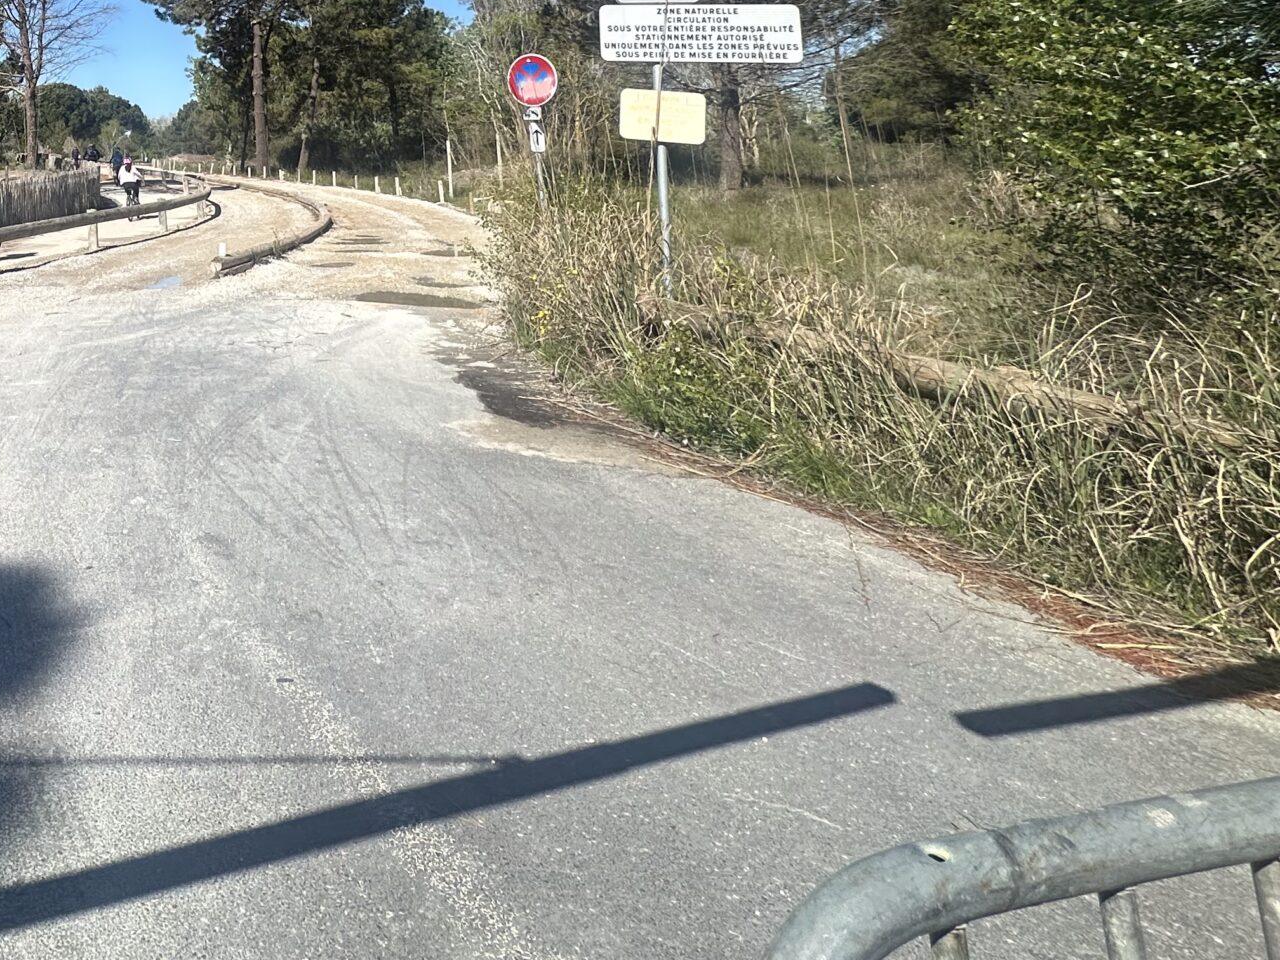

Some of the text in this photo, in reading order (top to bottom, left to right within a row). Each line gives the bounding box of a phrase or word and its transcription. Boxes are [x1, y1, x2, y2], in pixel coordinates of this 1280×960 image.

[656, 7, 739, 15] ZONE NATURELLE
[667, 16, 729, 24] CIRCULATION
[607, 24, 795, 33] SOUS VOTRE ENTIÈRE RESPONSABILITÉ
[634, 33, 765, 41] STATIONNEMENT AUTORISÉ
[668, 42, 694, 50] DANS
[753, 42, 799, 51] PRÉVUES
[689, 51, 713, 59] MISE
